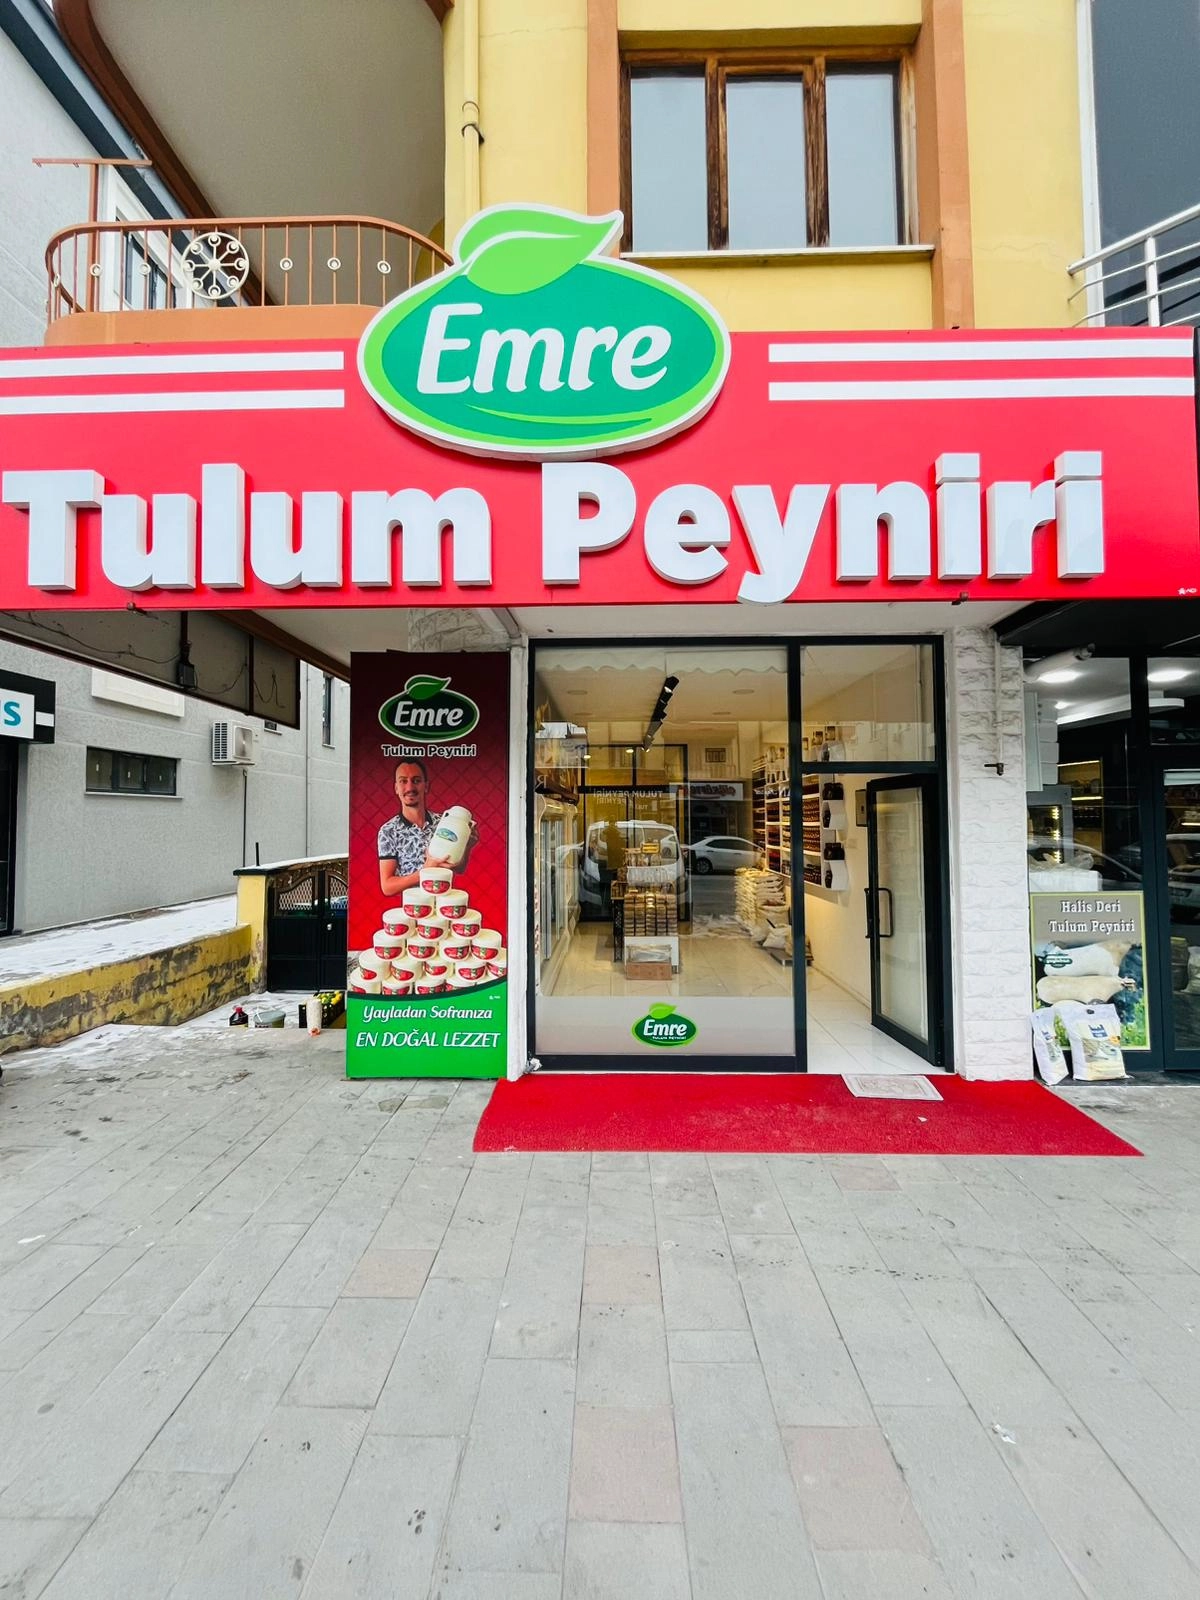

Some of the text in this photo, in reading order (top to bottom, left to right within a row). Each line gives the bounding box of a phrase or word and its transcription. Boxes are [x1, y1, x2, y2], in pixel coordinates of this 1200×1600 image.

[415, 302, 672, 395] Emre
[2, 451, 1105, 604] Tulum Peyniri
[394, 700, 464, 727] Emre
[382, 743, 477, 759] Tulum Peyniri
[1060, 900, 1122, 913] Halis Deri
[1048, 919, 1136, 936] Tulum Peyniri
[363, 1005, 493, 1023] Yayladan Sofranıza
[643, 1019, 688, 1036] Emre
[356, 1028, 501, 1047] EN DOĞAL LEZZET
